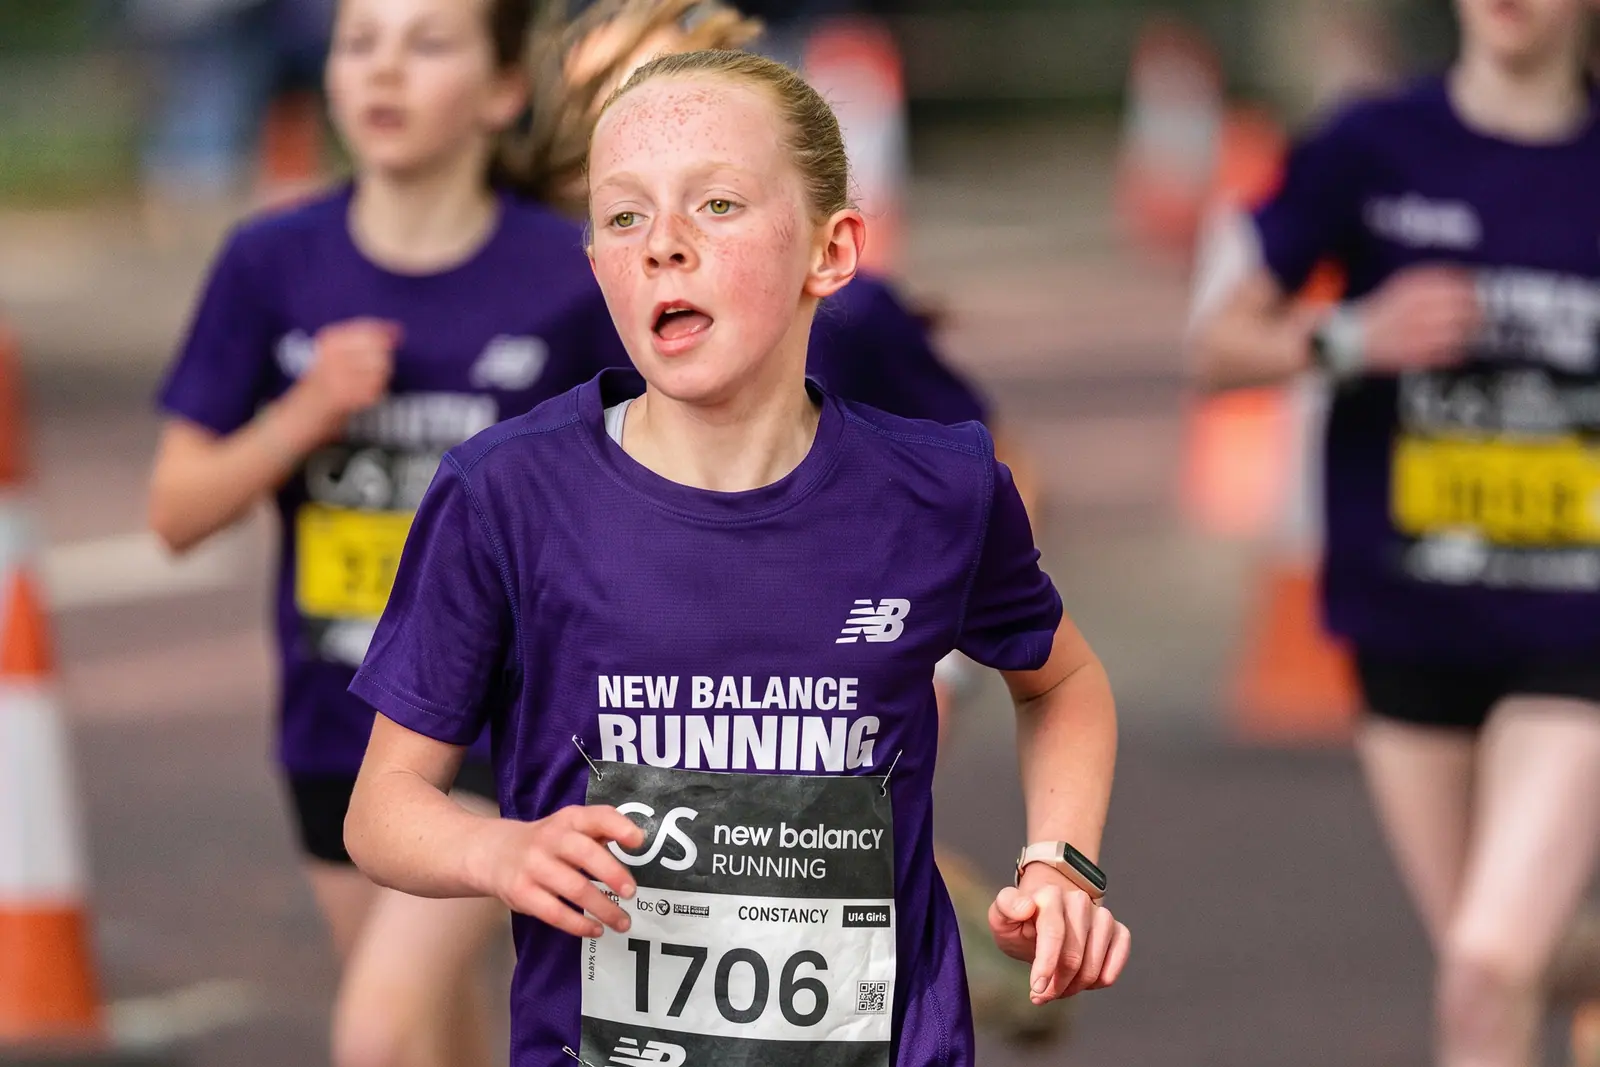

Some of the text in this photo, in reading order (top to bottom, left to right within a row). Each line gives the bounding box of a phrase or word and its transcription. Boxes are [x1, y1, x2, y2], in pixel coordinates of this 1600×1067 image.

[835, 598, 911, 644] NB
[598, 675, 859, 710] NEW BALANCE
[598, 713, 880, 771] RUNNING
[713, 824, 774, 846] new
[712, 853, 827, 879] RUNNING
[738, 905, 829, 924] CONSTANCY
[848, 911, 887, 922] U14 Girls
[627, 937, 829, 1027] 1706
